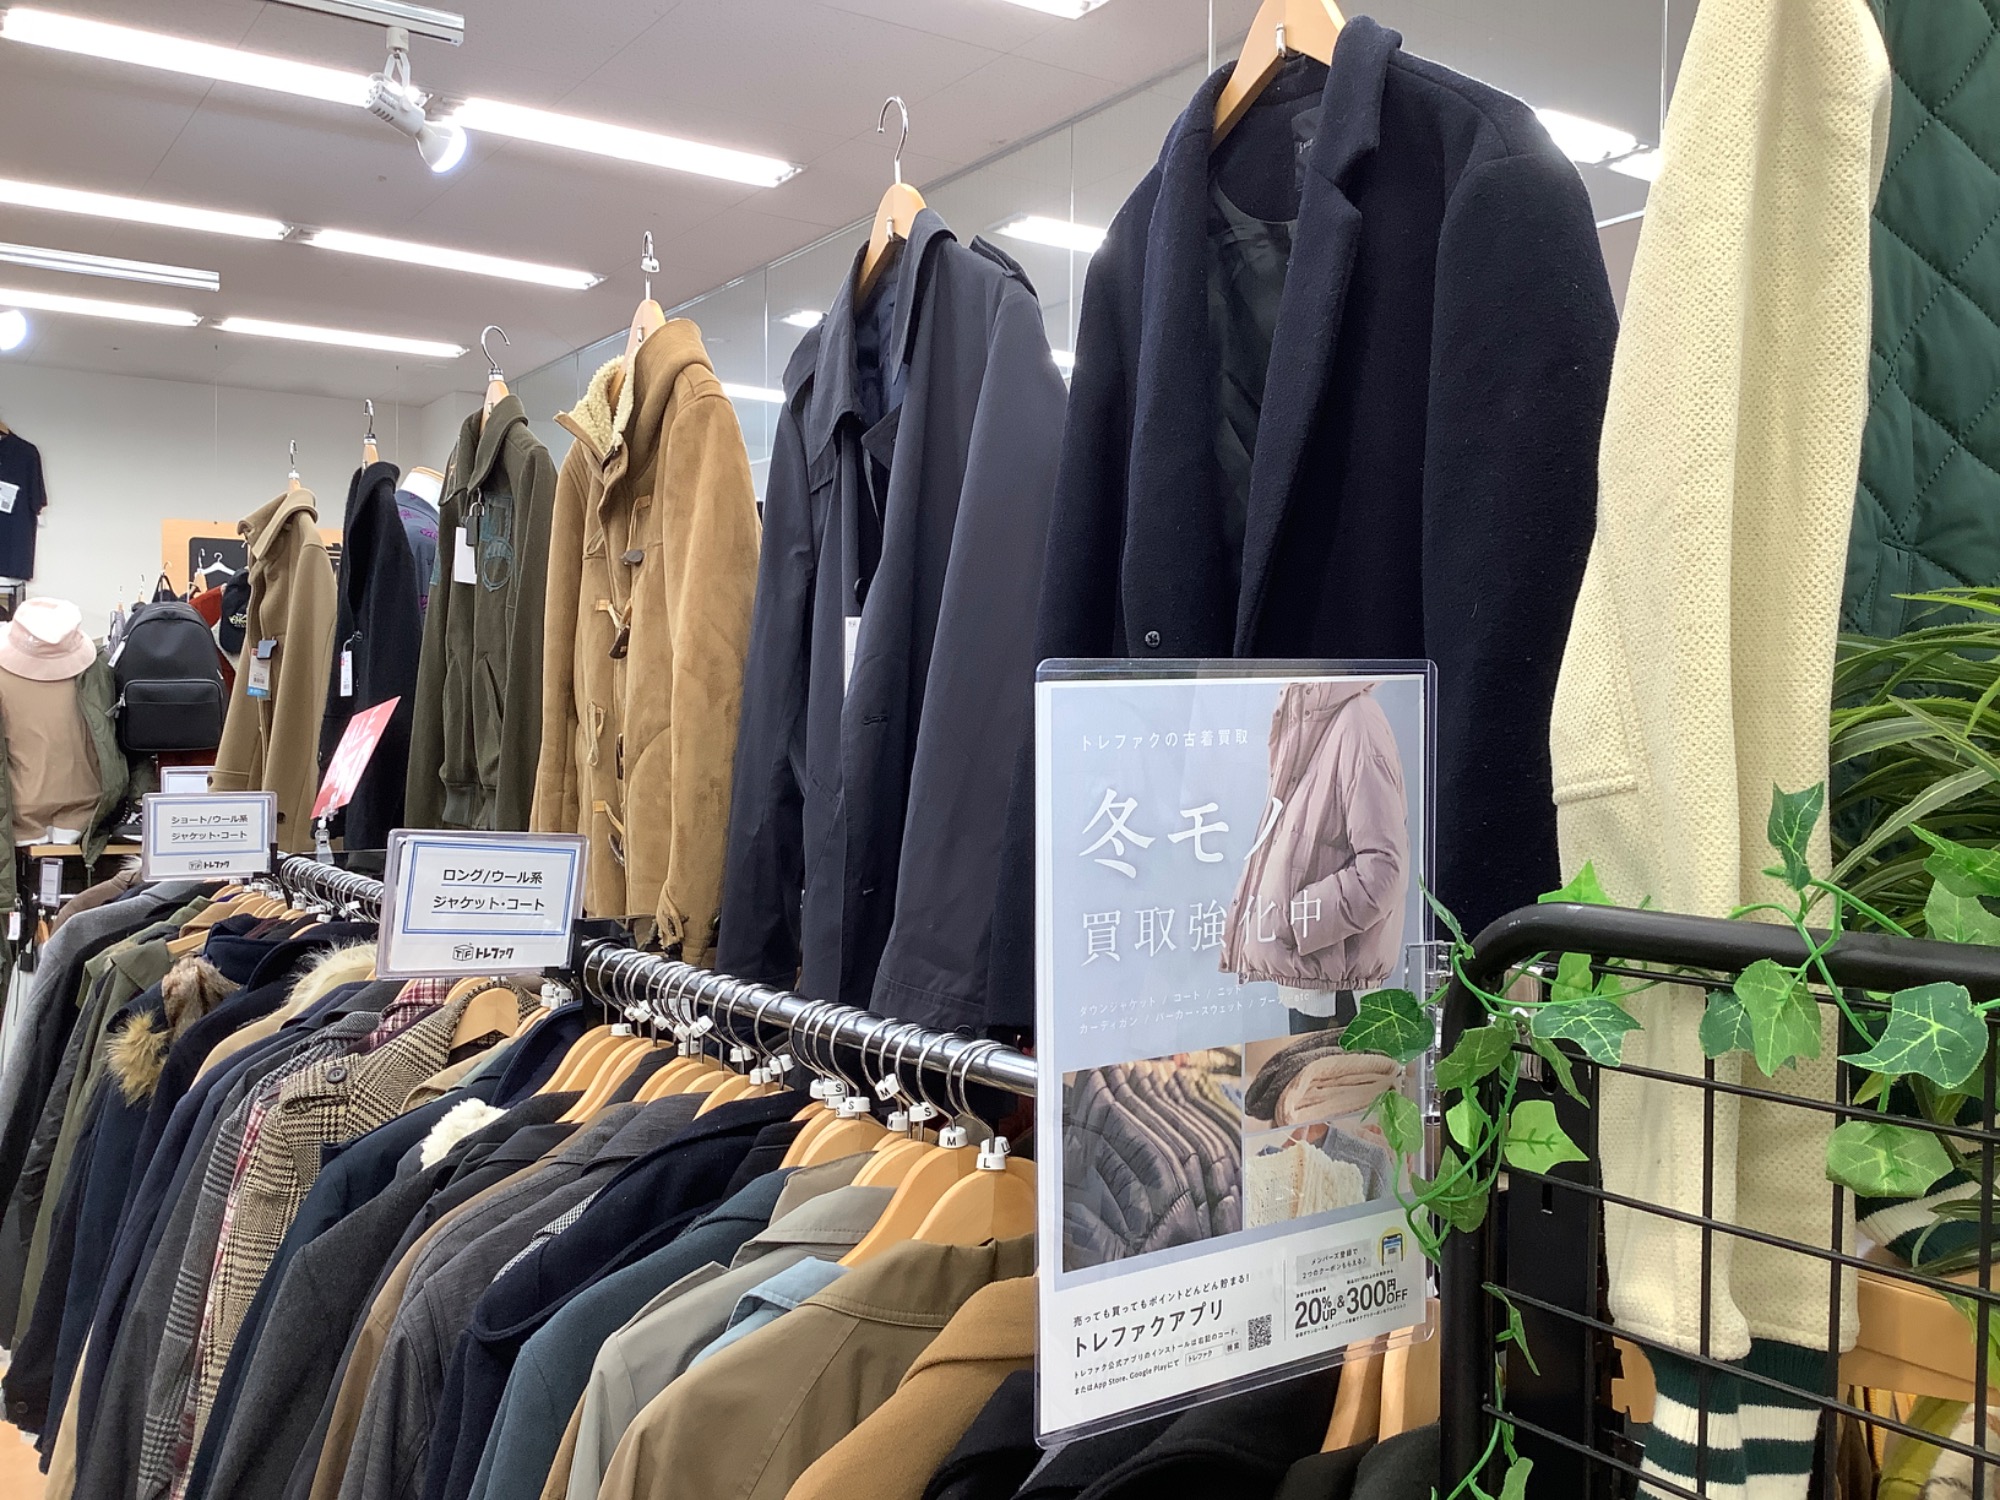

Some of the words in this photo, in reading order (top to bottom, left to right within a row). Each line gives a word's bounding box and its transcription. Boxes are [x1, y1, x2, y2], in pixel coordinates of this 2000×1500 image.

[1082, 728, 1249, 751] トレファクの古着買取
[171, 815, 248, 825] ショート/ウール系
[1078, 788, 1284, 880] 冬モノ
[443, 869, 543, 884] ロング/ウール系
[433, 895, 545, 911] ジャケット・コート
[1081, 889, 1322, 968] 買取強化中
[475, 947, 514, 959] トレファク
[835, 1083, 843, 1093] S
[882, 1088, 891, 1098] M
[848, 1100, 855, 1110] S
[924, 1106, 932, 1117] S
[947, 1136, 957, 1147] M
[983, 1157, 991, 1168] L
[1074, 1299, 1224, 1359] トレファクアプリ
